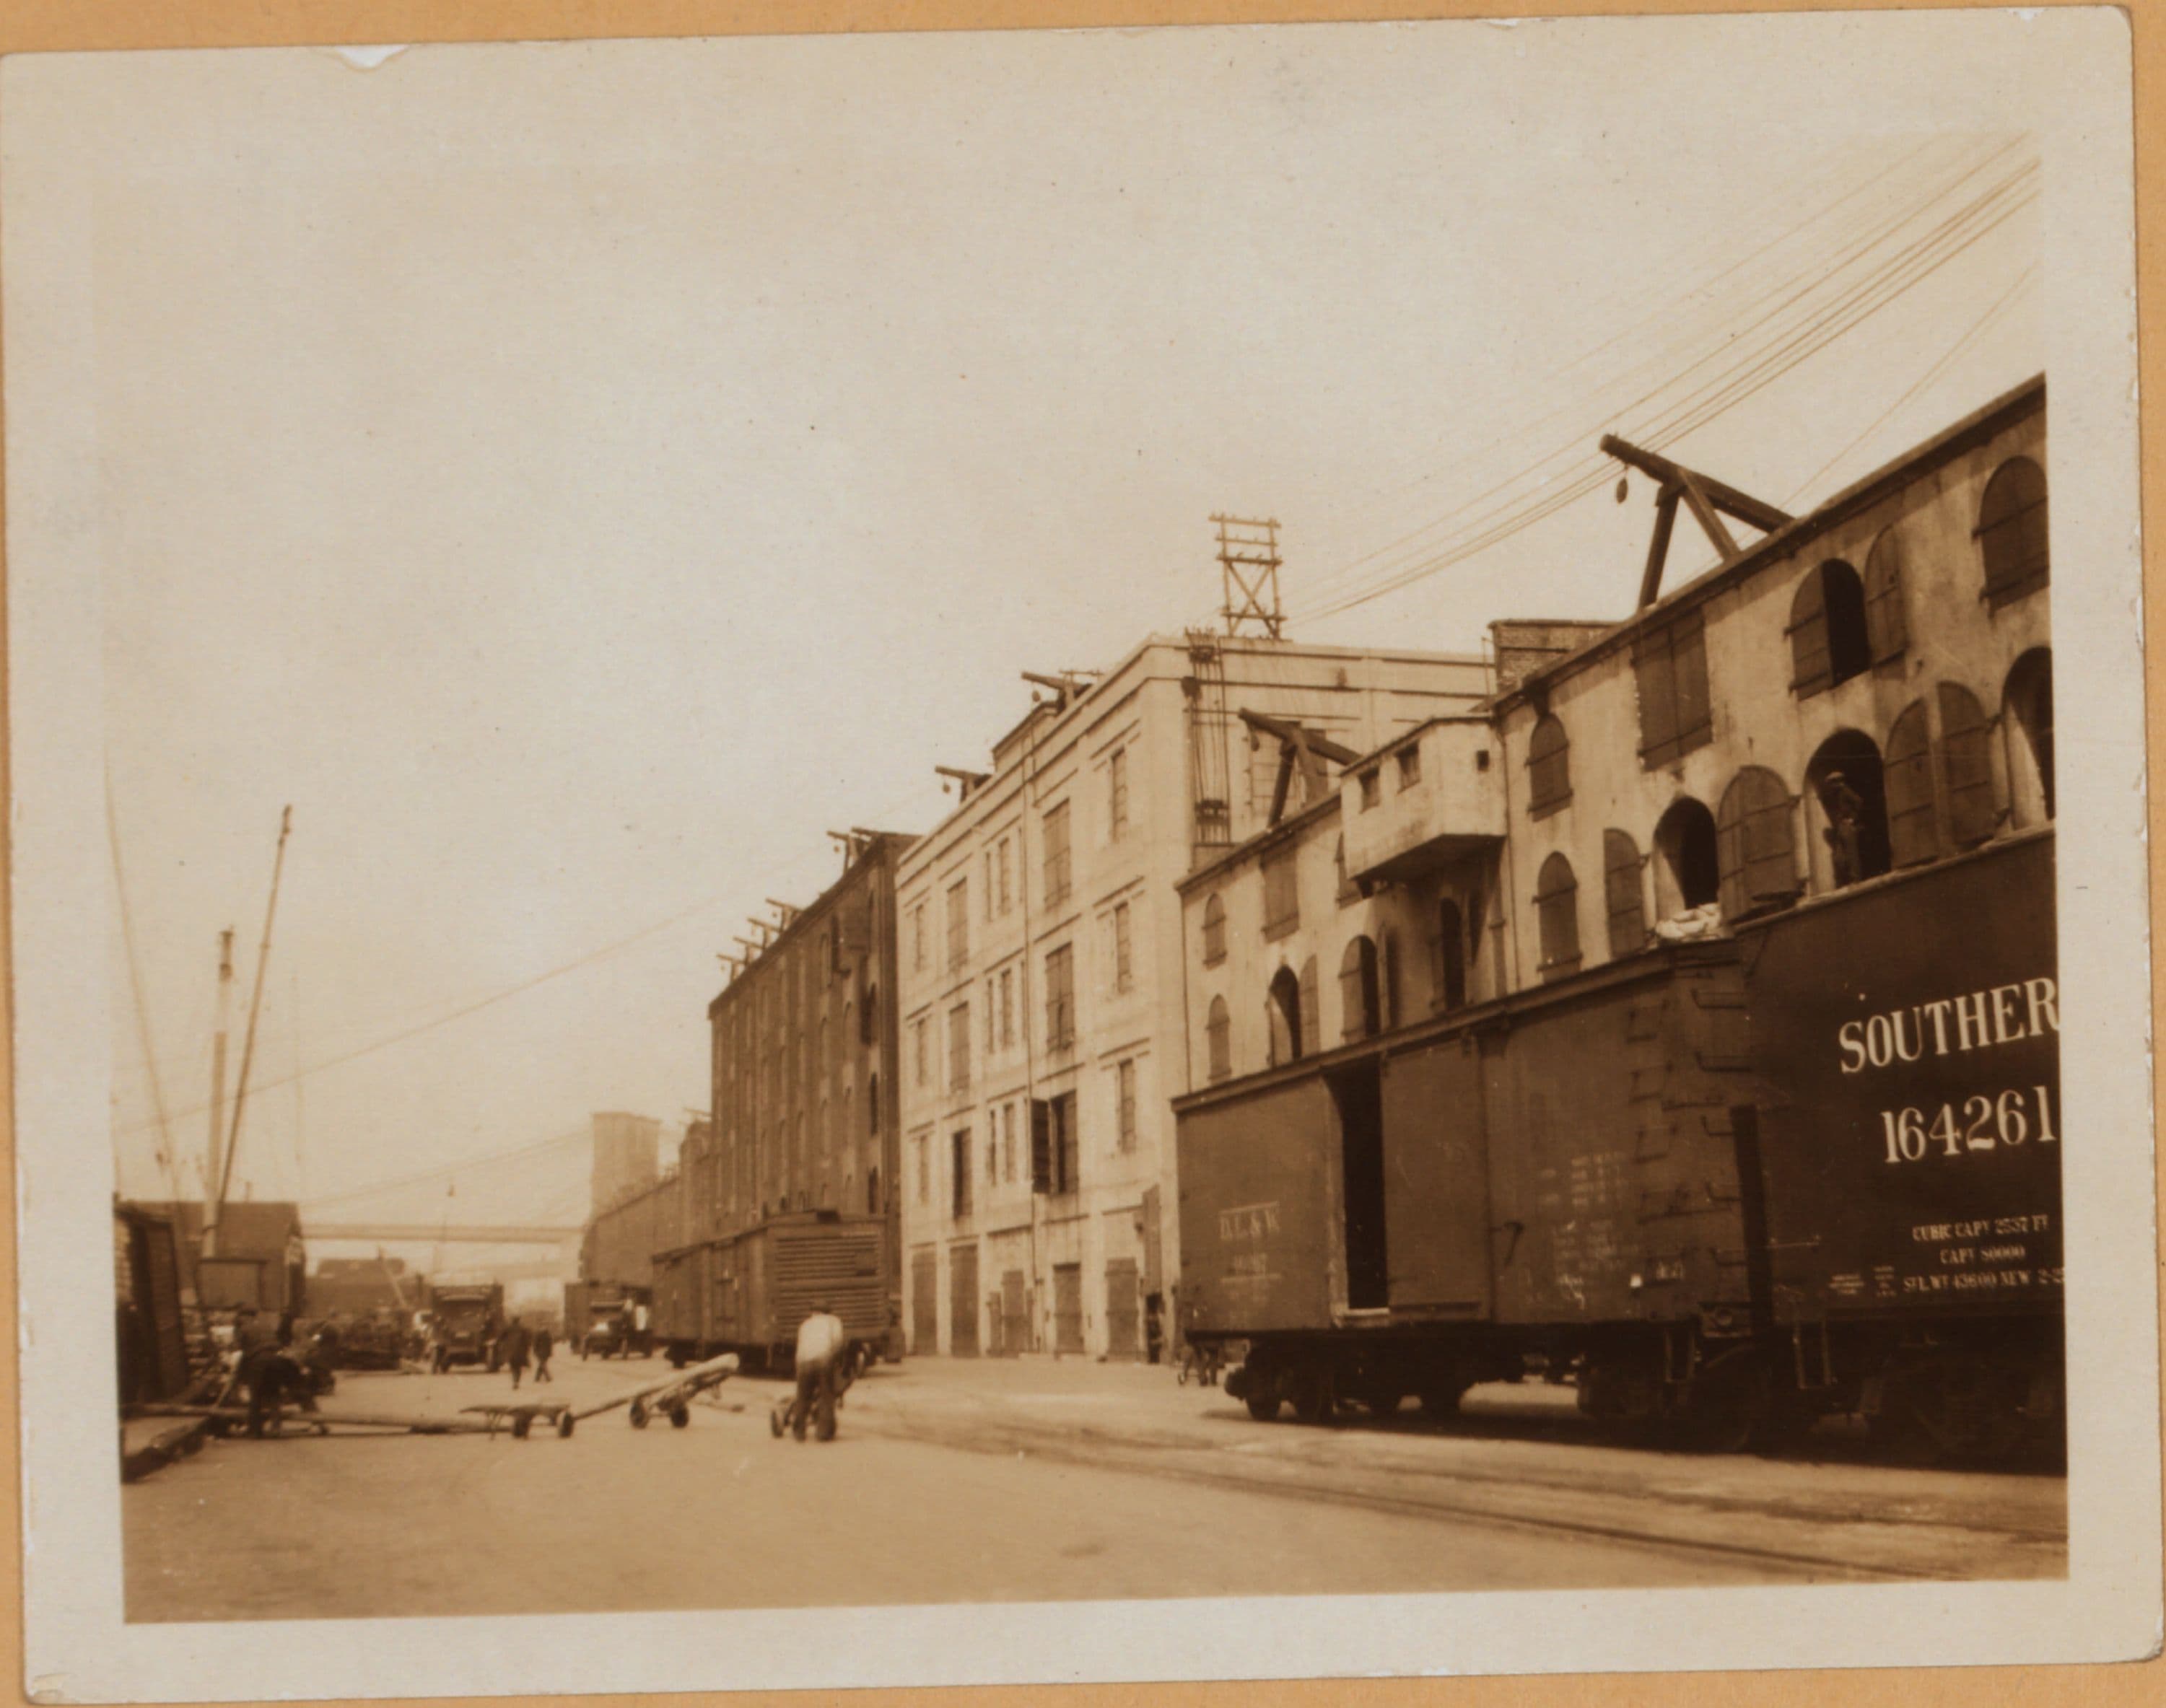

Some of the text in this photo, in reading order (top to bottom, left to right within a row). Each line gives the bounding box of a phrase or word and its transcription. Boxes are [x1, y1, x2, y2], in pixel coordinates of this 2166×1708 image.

[1838, 977, 2059, 1074] SOUTHER
[1881, 1086, 2057, 1164] 164261
[1912, 1225, 1952, 1241] CUBIC
[2032, 1214, 2048, 1231] FT
